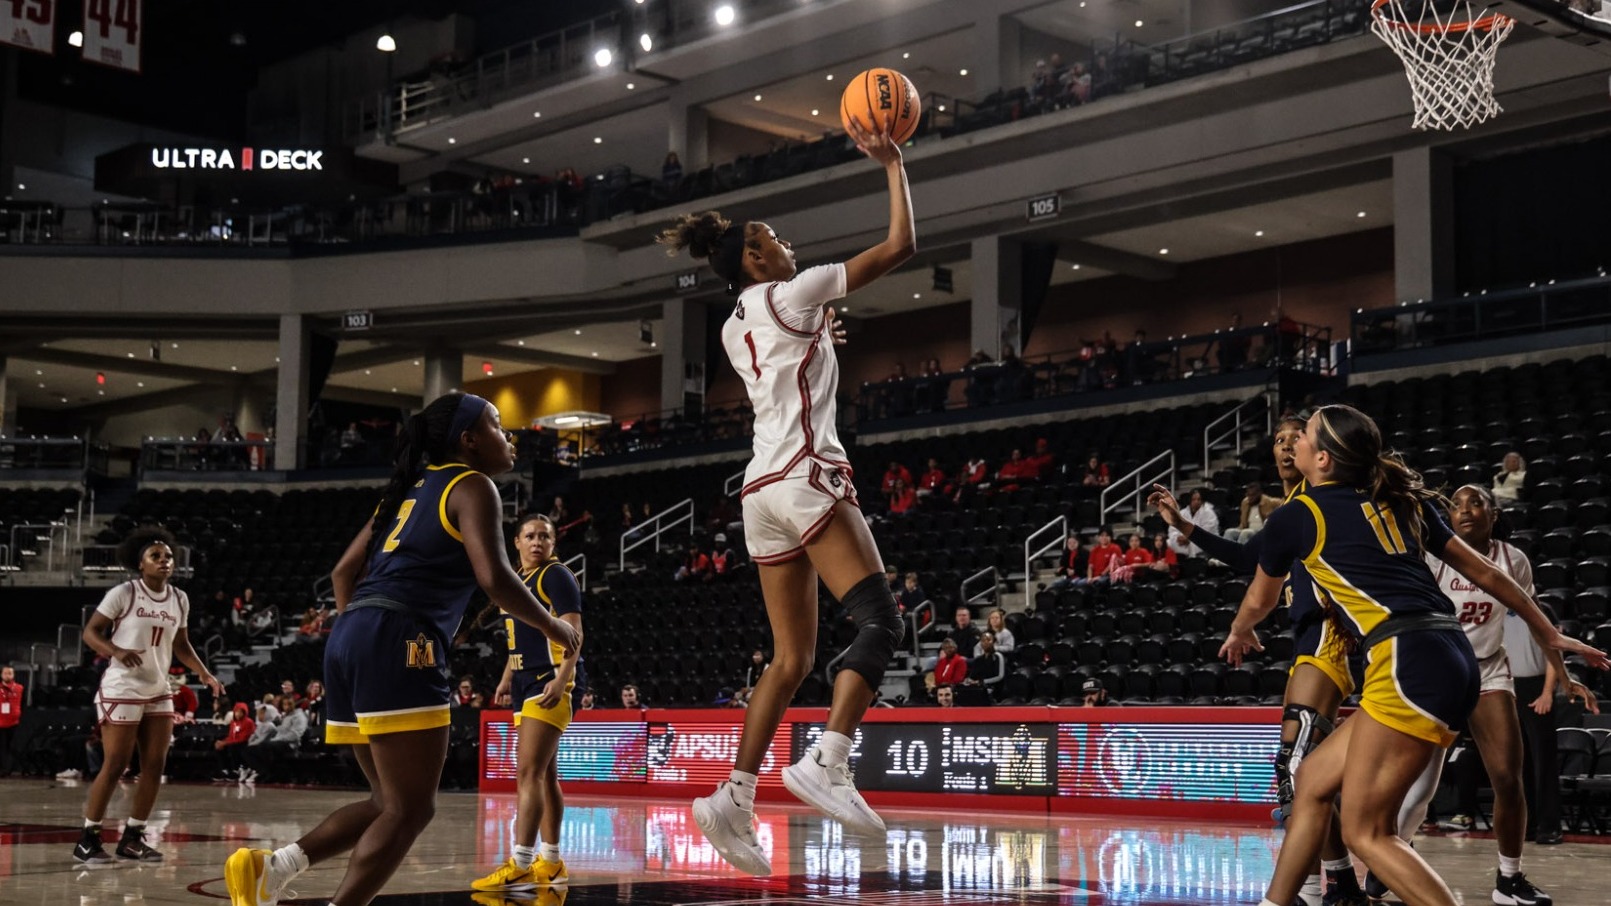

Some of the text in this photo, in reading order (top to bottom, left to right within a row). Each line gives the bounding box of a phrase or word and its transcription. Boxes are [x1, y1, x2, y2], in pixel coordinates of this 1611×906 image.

[876, 74, 892, 110] NCAA
[152, 148, 323, 170] ULTRA DECK
[1032, 199, 1055, 216] 105
[679, 274, 695, 288] 104
[348, 315, 366, 327] 103
[744, 330, 762, 381] 1
[383, 499, 417, 553] 2
[1360, 501, 1407, 555] 11
[136, 607, 160, 618] Austin
[1459, 601, 1493, 626] 23
[151, 626, 164, 647] 11
[674, 734, 730, 759] APSU
[886, 740, 928, 775] 10
